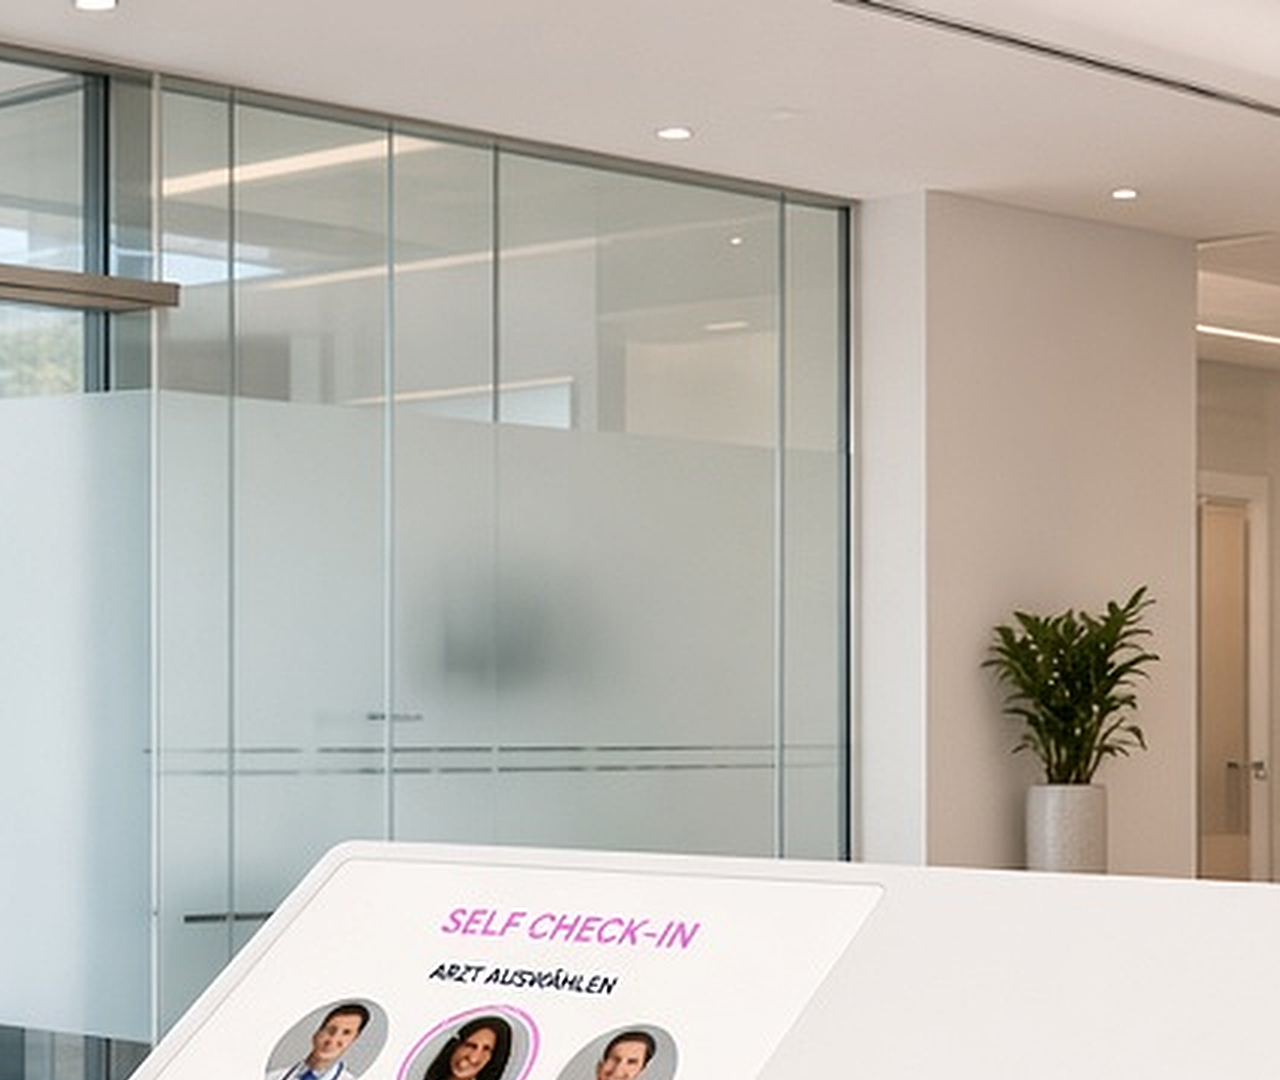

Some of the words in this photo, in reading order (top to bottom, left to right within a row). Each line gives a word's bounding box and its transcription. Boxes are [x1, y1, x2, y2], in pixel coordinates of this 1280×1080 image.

[440, 907, 527, 937] SELF
[527, 911, 702, 950] CHECK-IN
[428, 963, 486, 984] ARZT
